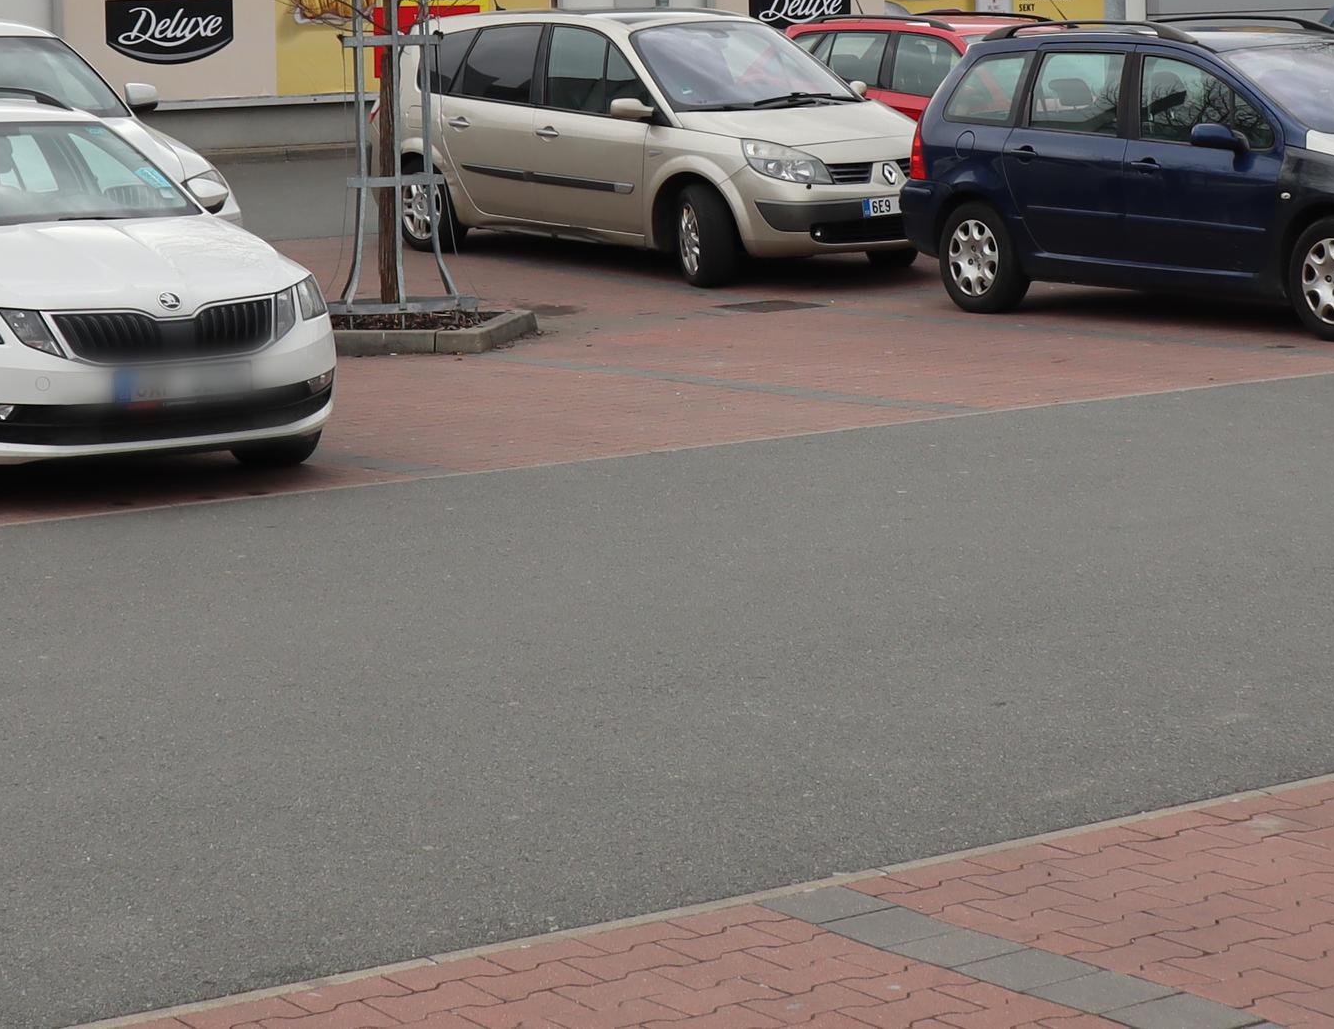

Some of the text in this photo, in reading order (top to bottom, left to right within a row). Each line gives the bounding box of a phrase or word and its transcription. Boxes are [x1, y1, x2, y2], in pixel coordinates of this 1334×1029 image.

[1019, 4, 1035, 12] SEKT
[118, 7, 222, 47] Deluxe
[872, 199, 891, 214] 6E9
